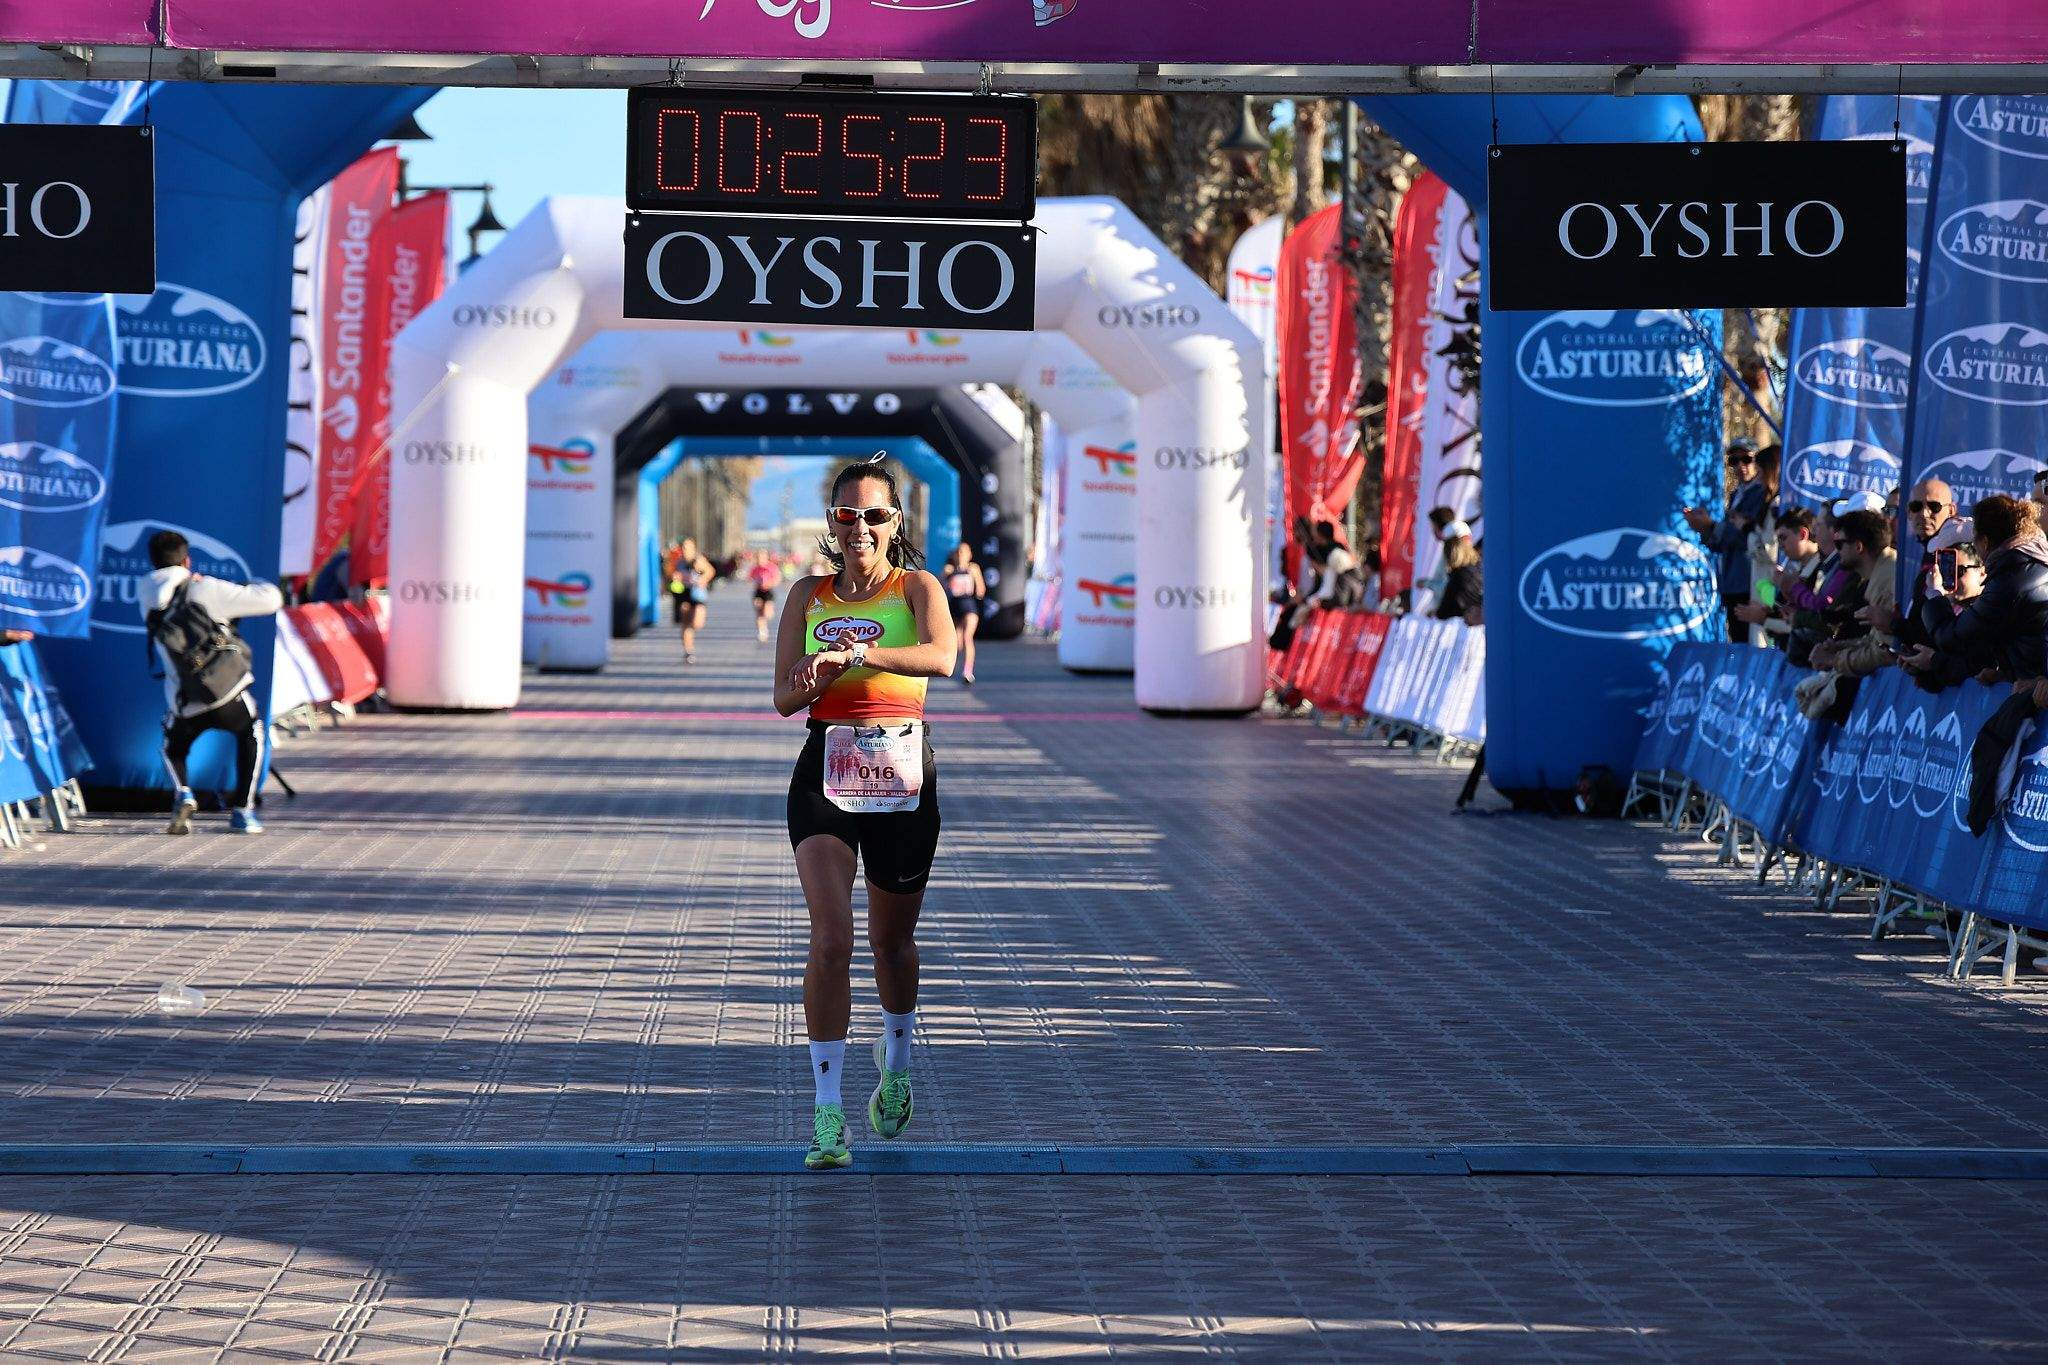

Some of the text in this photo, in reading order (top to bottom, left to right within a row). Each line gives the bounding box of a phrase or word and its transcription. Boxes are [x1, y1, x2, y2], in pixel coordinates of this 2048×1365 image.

[1965, 97, 2048, 138] ASTUR
[657, 109, 1006, 200] 00:25:23
[1557, 200, 1845, 259] OYSHO
[1949, 222, 2048, 263] ASTURI
[645, 231, 1015, 314] OYSHO
[329, 201, 373, 391] Santander
[1098, 304, 1200, 328] OYSHO
[452, 304, 556, 329] OYSHO
[1301, 257, 1331, 416] Santander
[117, 336, 252, 373] TURIANA
[1935, 347, 2048, 386] ASTURIA
[1804, 357, 1908, 397] ASTURIAN
[695, 392, 901, 414] VOLVO
[1794, 458, 1899, 494] ASTURIAN
[858, 766, 895, 779] 016
